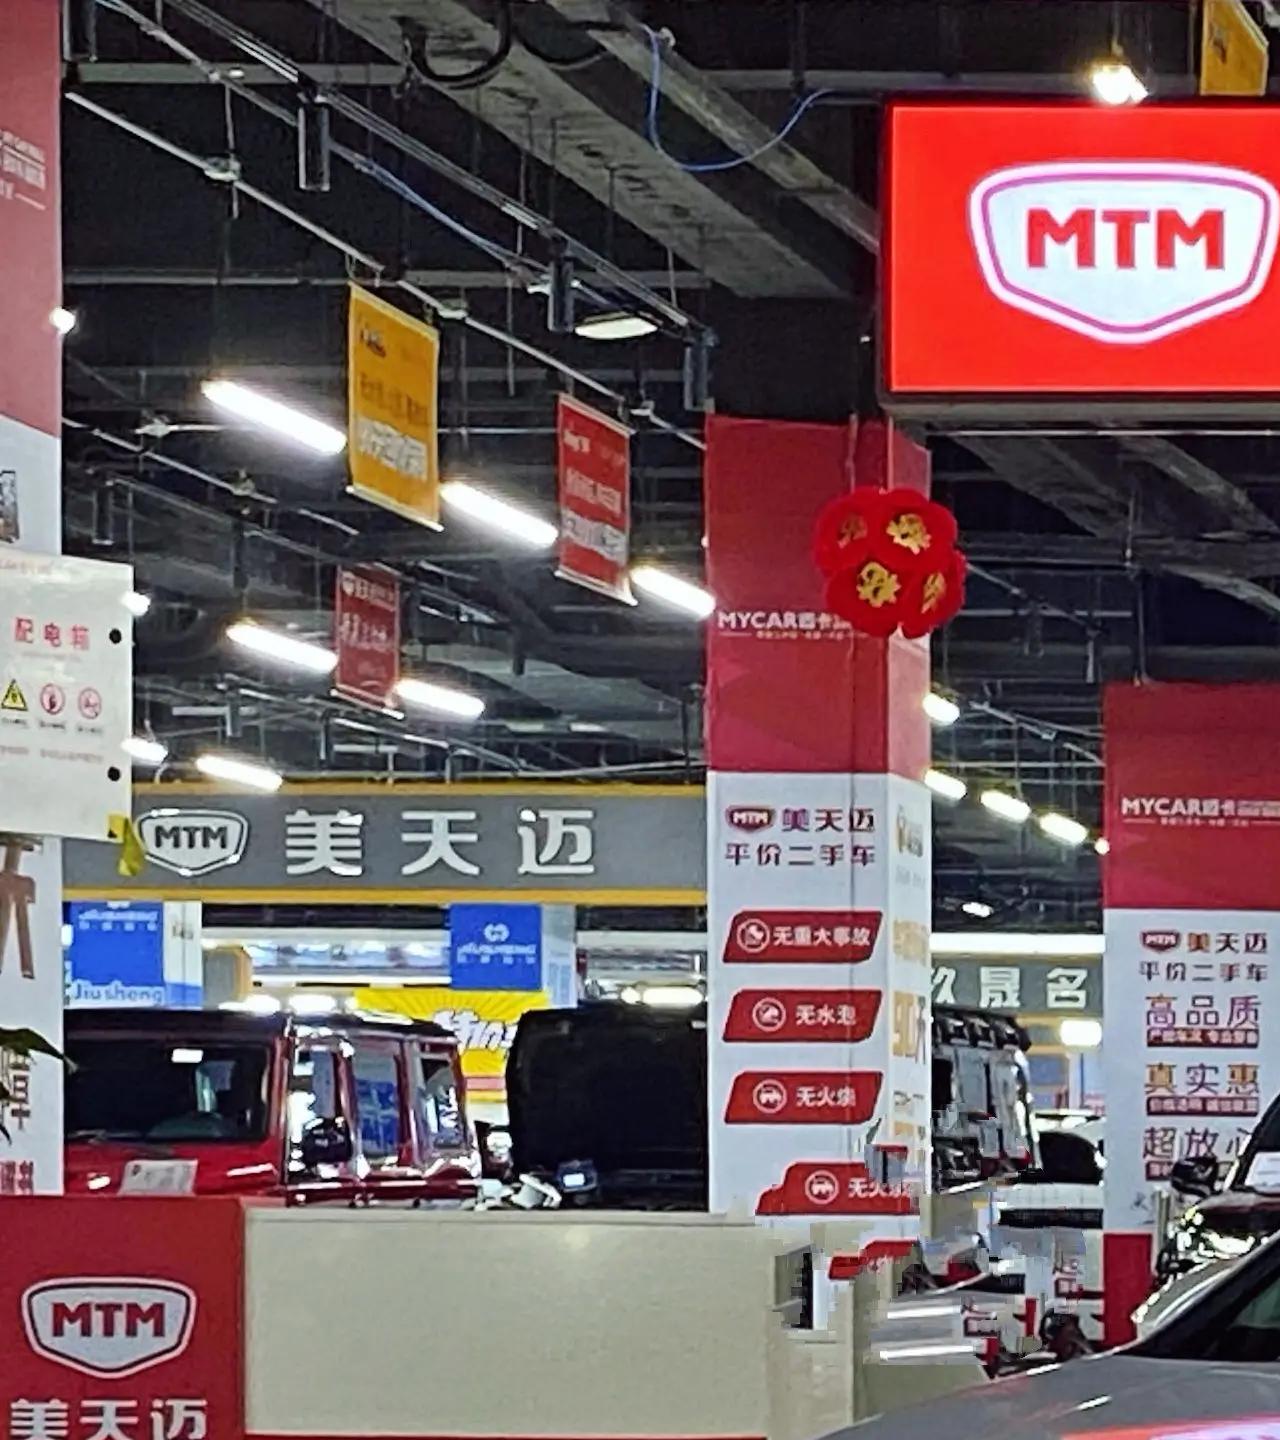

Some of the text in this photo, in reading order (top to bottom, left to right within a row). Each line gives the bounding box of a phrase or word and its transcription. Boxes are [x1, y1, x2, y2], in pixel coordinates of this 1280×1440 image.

[1025, 207, 1226, 271] MTM
[781, 807, 876, 833] 美天迈
[154, 809, 595, 877] MTM 美天迈
[725, 842, 876, 867] 平价二手车
[773, 925, 872, 947] 无重大事故
[1187, 931, 1268, 954] 美天迈
[1139, 960, 1268, 983] 平价二手车
[74, 983, 163, 1003] Jiusheng
[795, 1003, 857, 1027] 无水泡
[1145, 993, 1262, 1029] 高品质
[1144, 1062, 1261, 1096] 真实惠
[796, 1084, 857, 1108] 无火烧
[1143, 1126, 1253, 1160] 超放心
[52, 1302, 166, 1339] MTM
